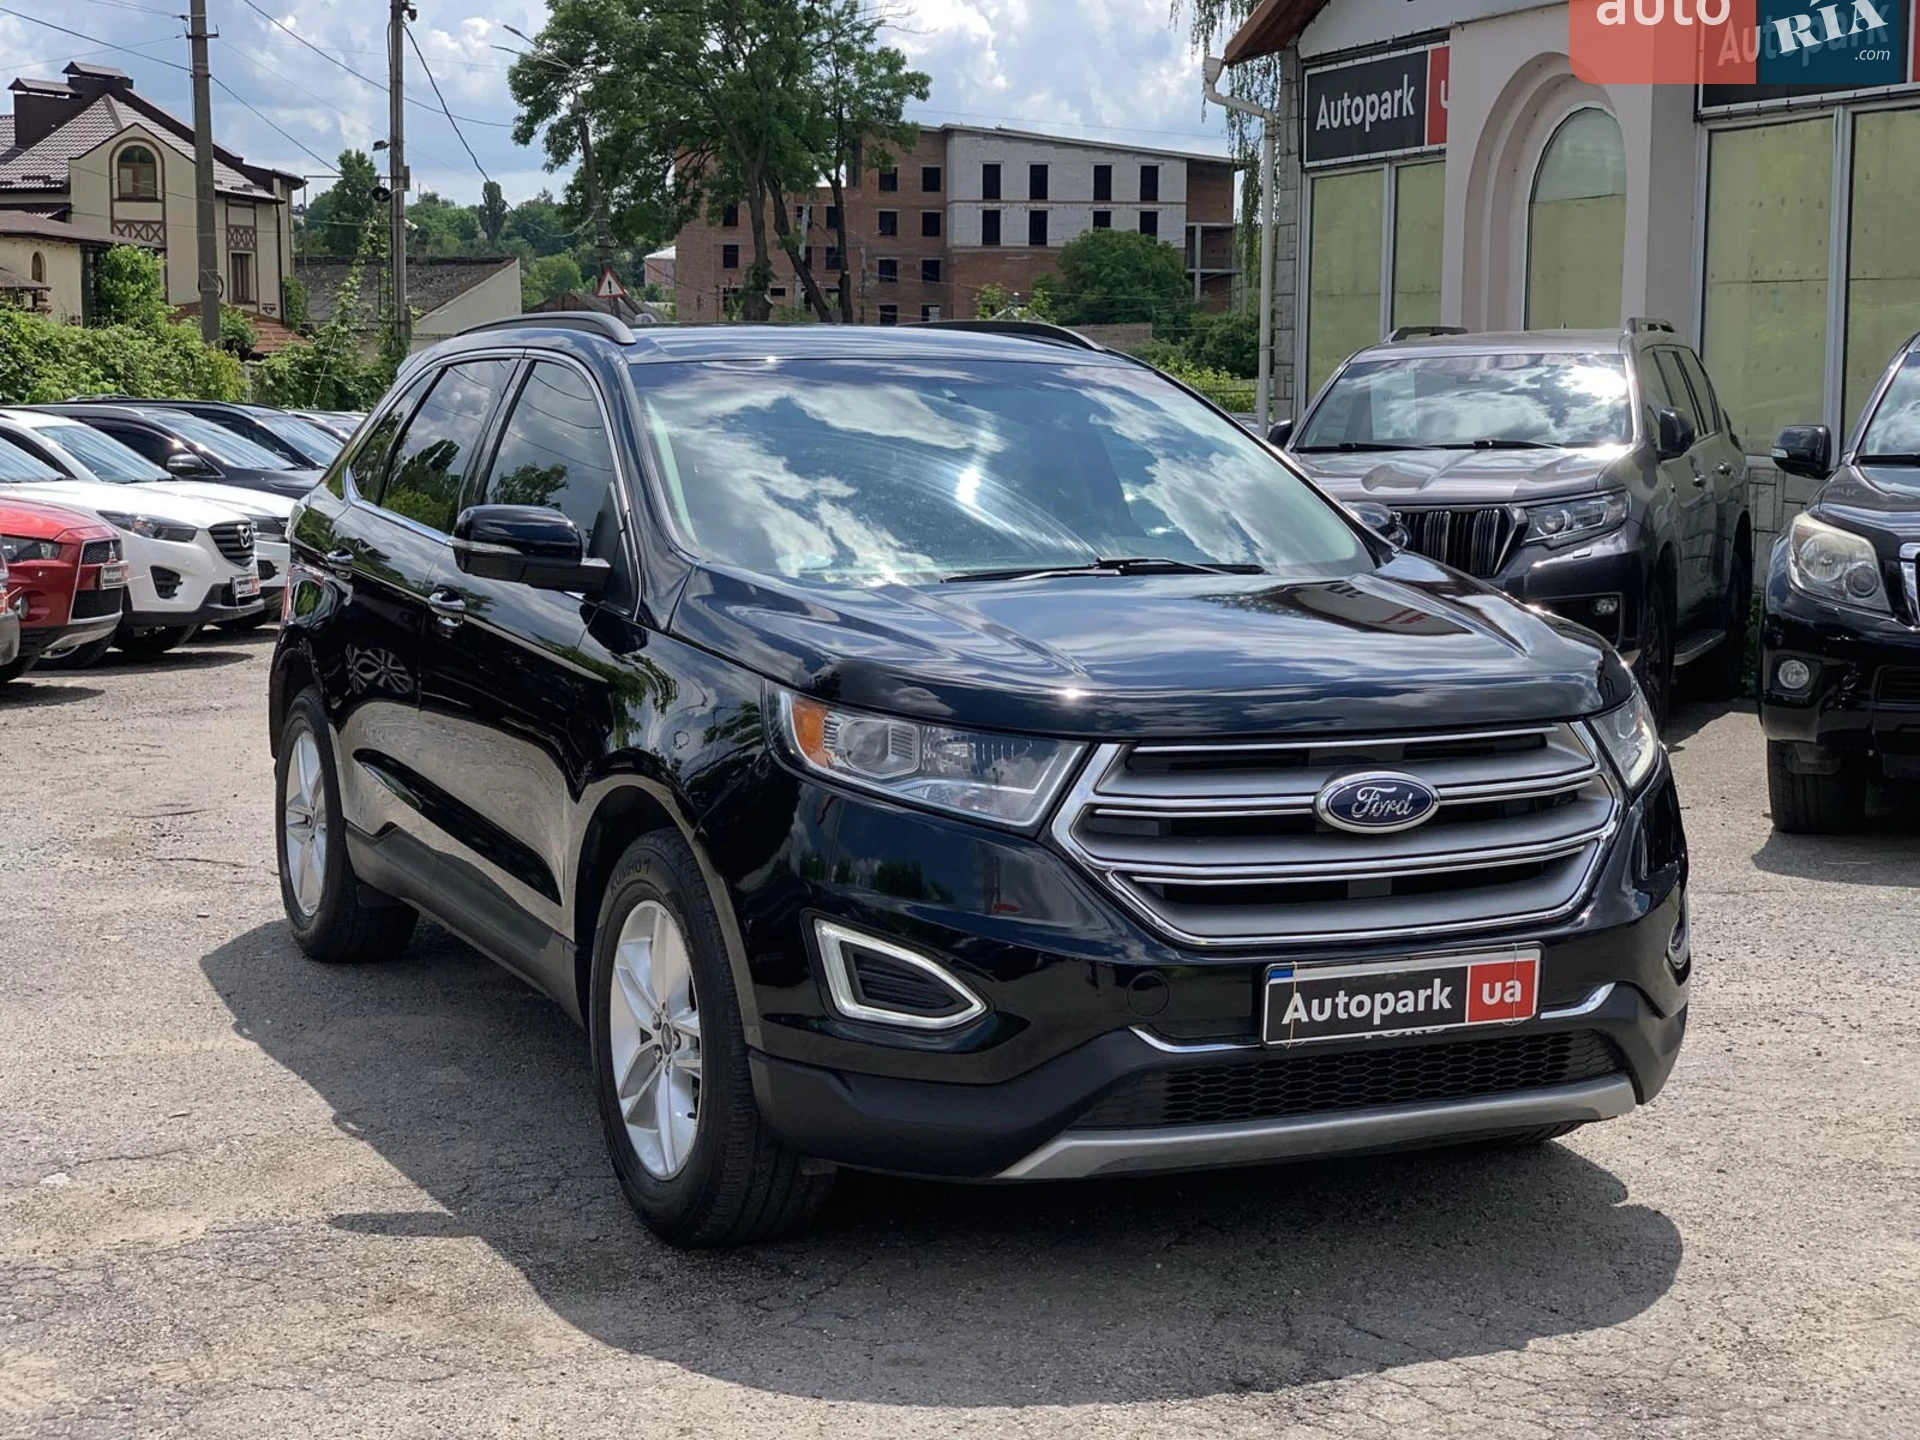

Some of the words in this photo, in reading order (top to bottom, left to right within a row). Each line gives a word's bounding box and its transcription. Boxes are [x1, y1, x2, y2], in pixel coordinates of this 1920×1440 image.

[1315, 73, 1415, 132] Autopark
[1351, 786, 1414, 818] Ford
[1281, 977, 1453, 1026] Autopark
[1481, 978, 1522, 1005] ua
